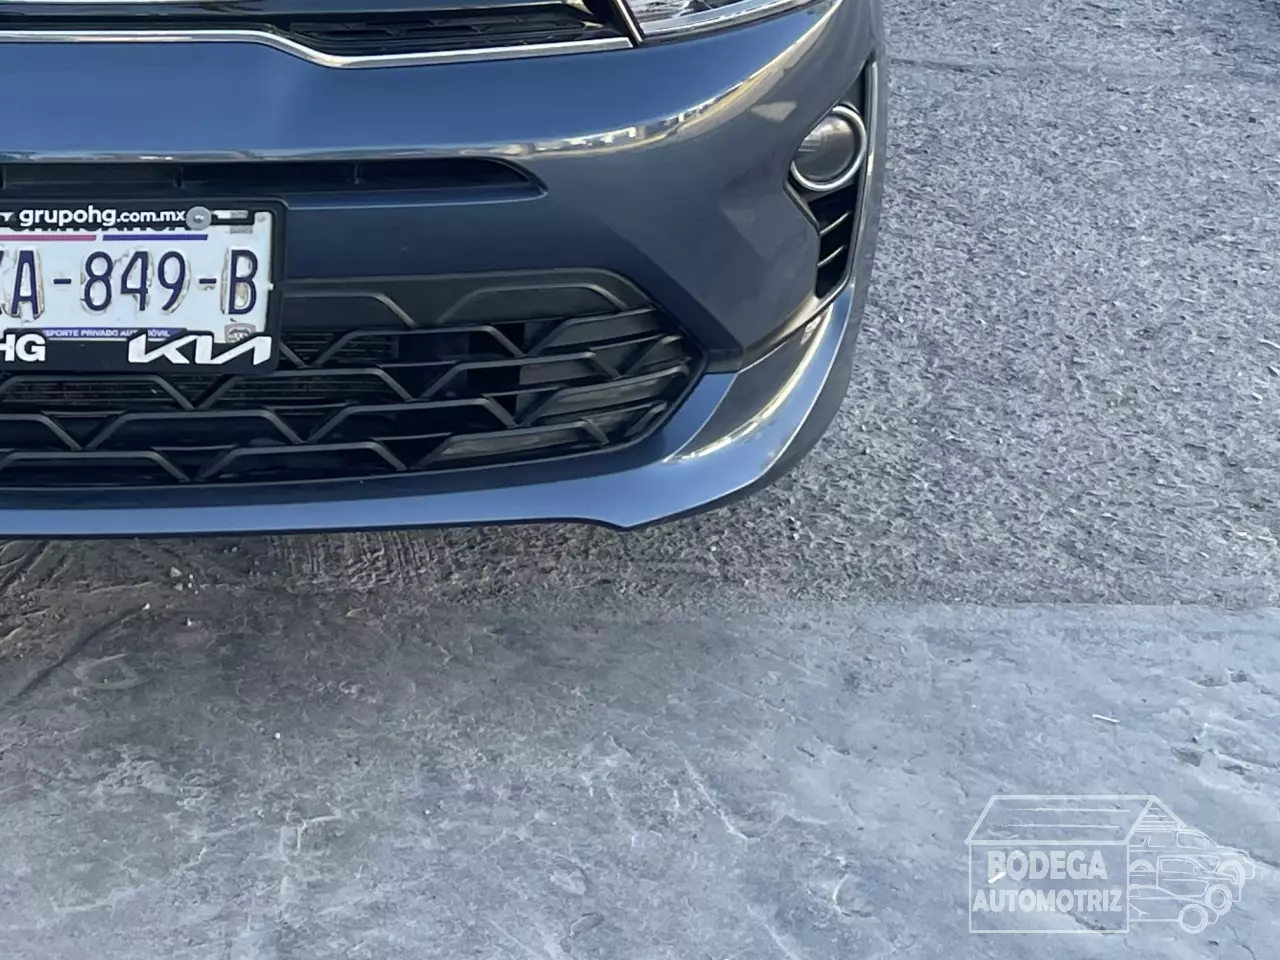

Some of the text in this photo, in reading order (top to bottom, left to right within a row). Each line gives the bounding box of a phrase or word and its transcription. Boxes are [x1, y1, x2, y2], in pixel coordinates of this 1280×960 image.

[18, 204, 187, 228] grupohg.com.mx
[80, 328, 118, 338] PRIVADO
[127, 333, 272, 366] KIA
